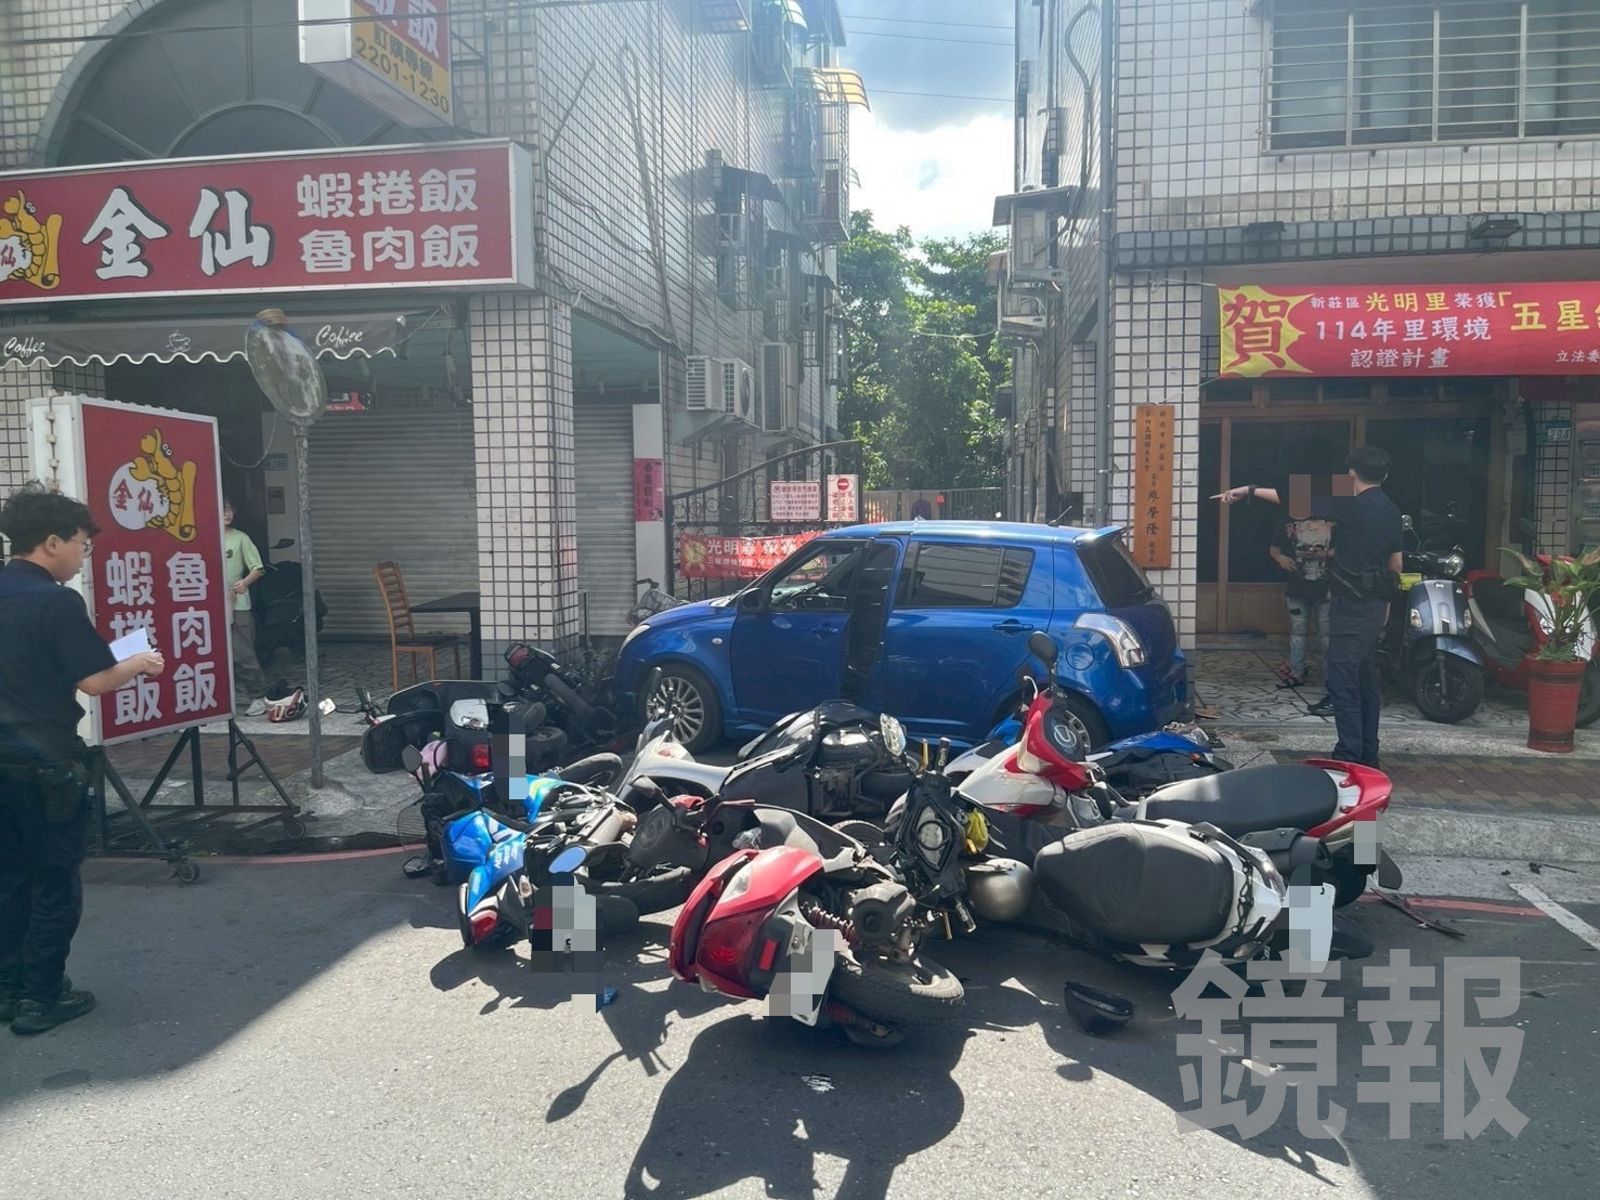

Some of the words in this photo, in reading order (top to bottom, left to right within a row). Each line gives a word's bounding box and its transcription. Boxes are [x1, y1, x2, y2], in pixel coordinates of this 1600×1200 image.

[355, 36, 450, 114] 2201-1230
[296, 167, 479, 220] 蝦捲飯
[82, 187, 274, 281] 金仙
[299, 222, 481, 273] 魯肉飯
[3, 336, 46, 358] Coffee
[1222, 293, 1290, 369] 賀
[1316, 316, 1492, 343] 114年里環境
[1350, 346, 1450, 370] 認證計畫
[112, 478, 156, 513] 金仙
[166, 551, 218, 714] 魯肉飯
